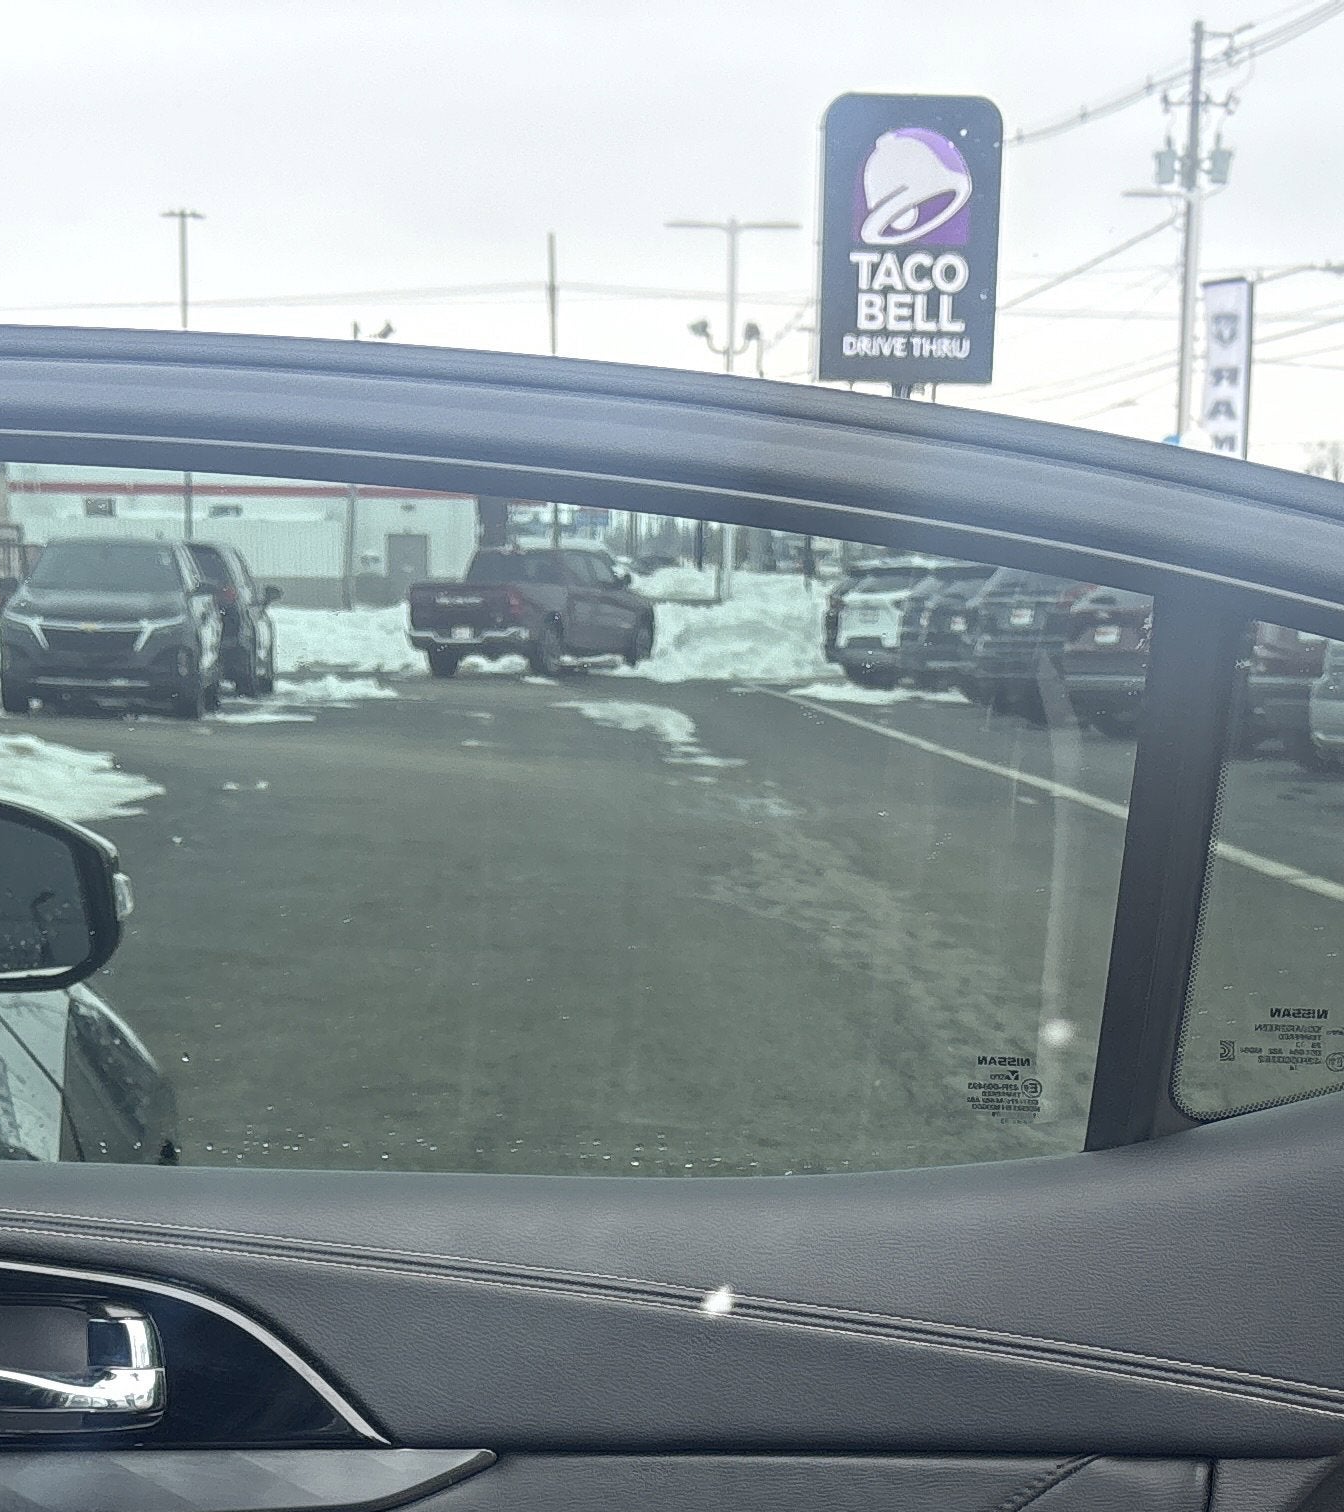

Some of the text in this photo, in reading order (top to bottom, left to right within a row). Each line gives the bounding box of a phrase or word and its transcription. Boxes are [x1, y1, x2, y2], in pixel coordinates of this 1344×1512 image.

[849, 251, 970, 292] TACO
[856, 292, 966, 332] BELL
[843, 334, 970, 358] DRIVE THRU
